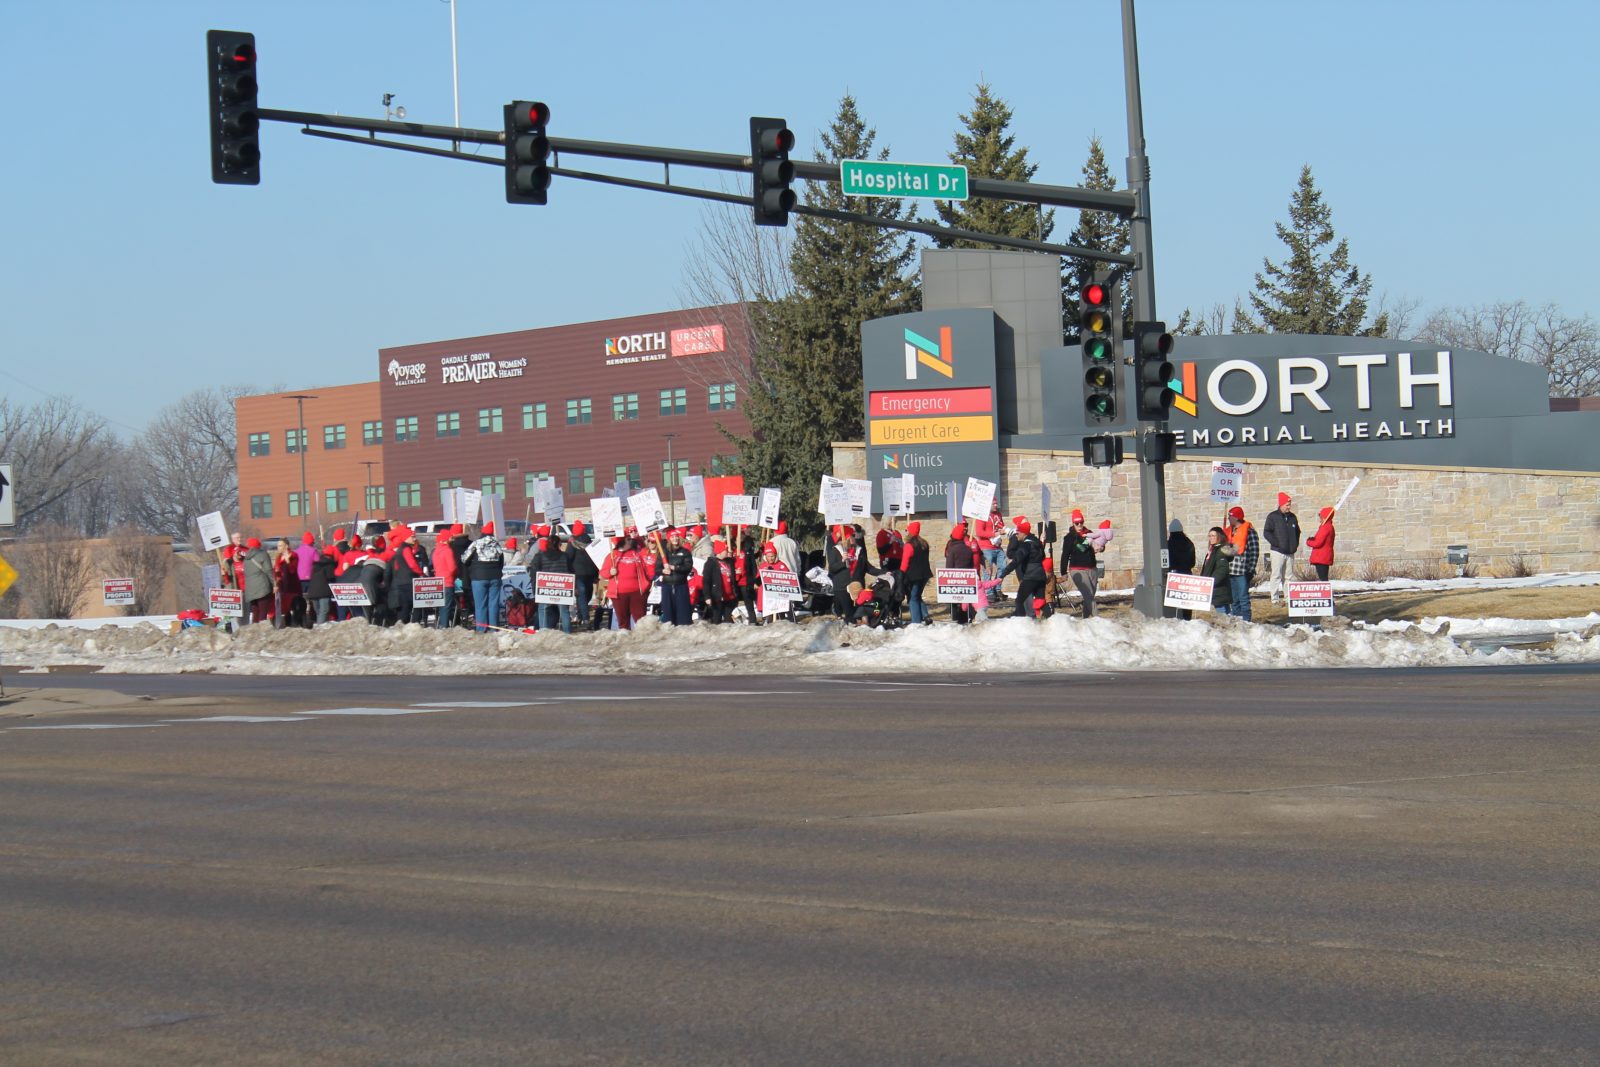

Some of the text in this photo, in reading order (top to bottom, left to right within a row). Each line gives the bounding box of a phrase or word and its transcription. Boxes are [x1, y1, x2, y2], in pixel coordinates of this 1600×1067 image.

[850, 168, 959, 192] Hospital Dr
[676, 329, 717, 342] URGENT
[606, 331, 666, 356] NORTH
[441, 352, 490, 365] OAKDALE OBGYN
[498, 357, 527, 369] WOMEN'S
[606, 353, 667, 366] MEMORIAL HEALTH
[391, 362, 426, 381] Voyage
[442, 361, 498, 384] PREMIER
[498, 368, 523, 378] HEALTH
[395, 378, 426, 386] HEALTHCARE
[882, 396, 951, 412] Emergency
[883, 423, 960, 441] Urgent Care
[1172, 418, 1454, 446] EMORIAL HEALTH
[903, 453, 943, 468] Clinics
[1213, 466, 1242, 474] PENSION
[1211, 489, 1240, 497] STRIKE
[762, 571, 797, 580] PATIENTS
[1169, 576, 1212, 587] PATIENTS
[539, 589, 571, 597] PROFITS
[940, 586, 975, 594] PROFITS
[1169, 591, 1208, 601] PROFITS
